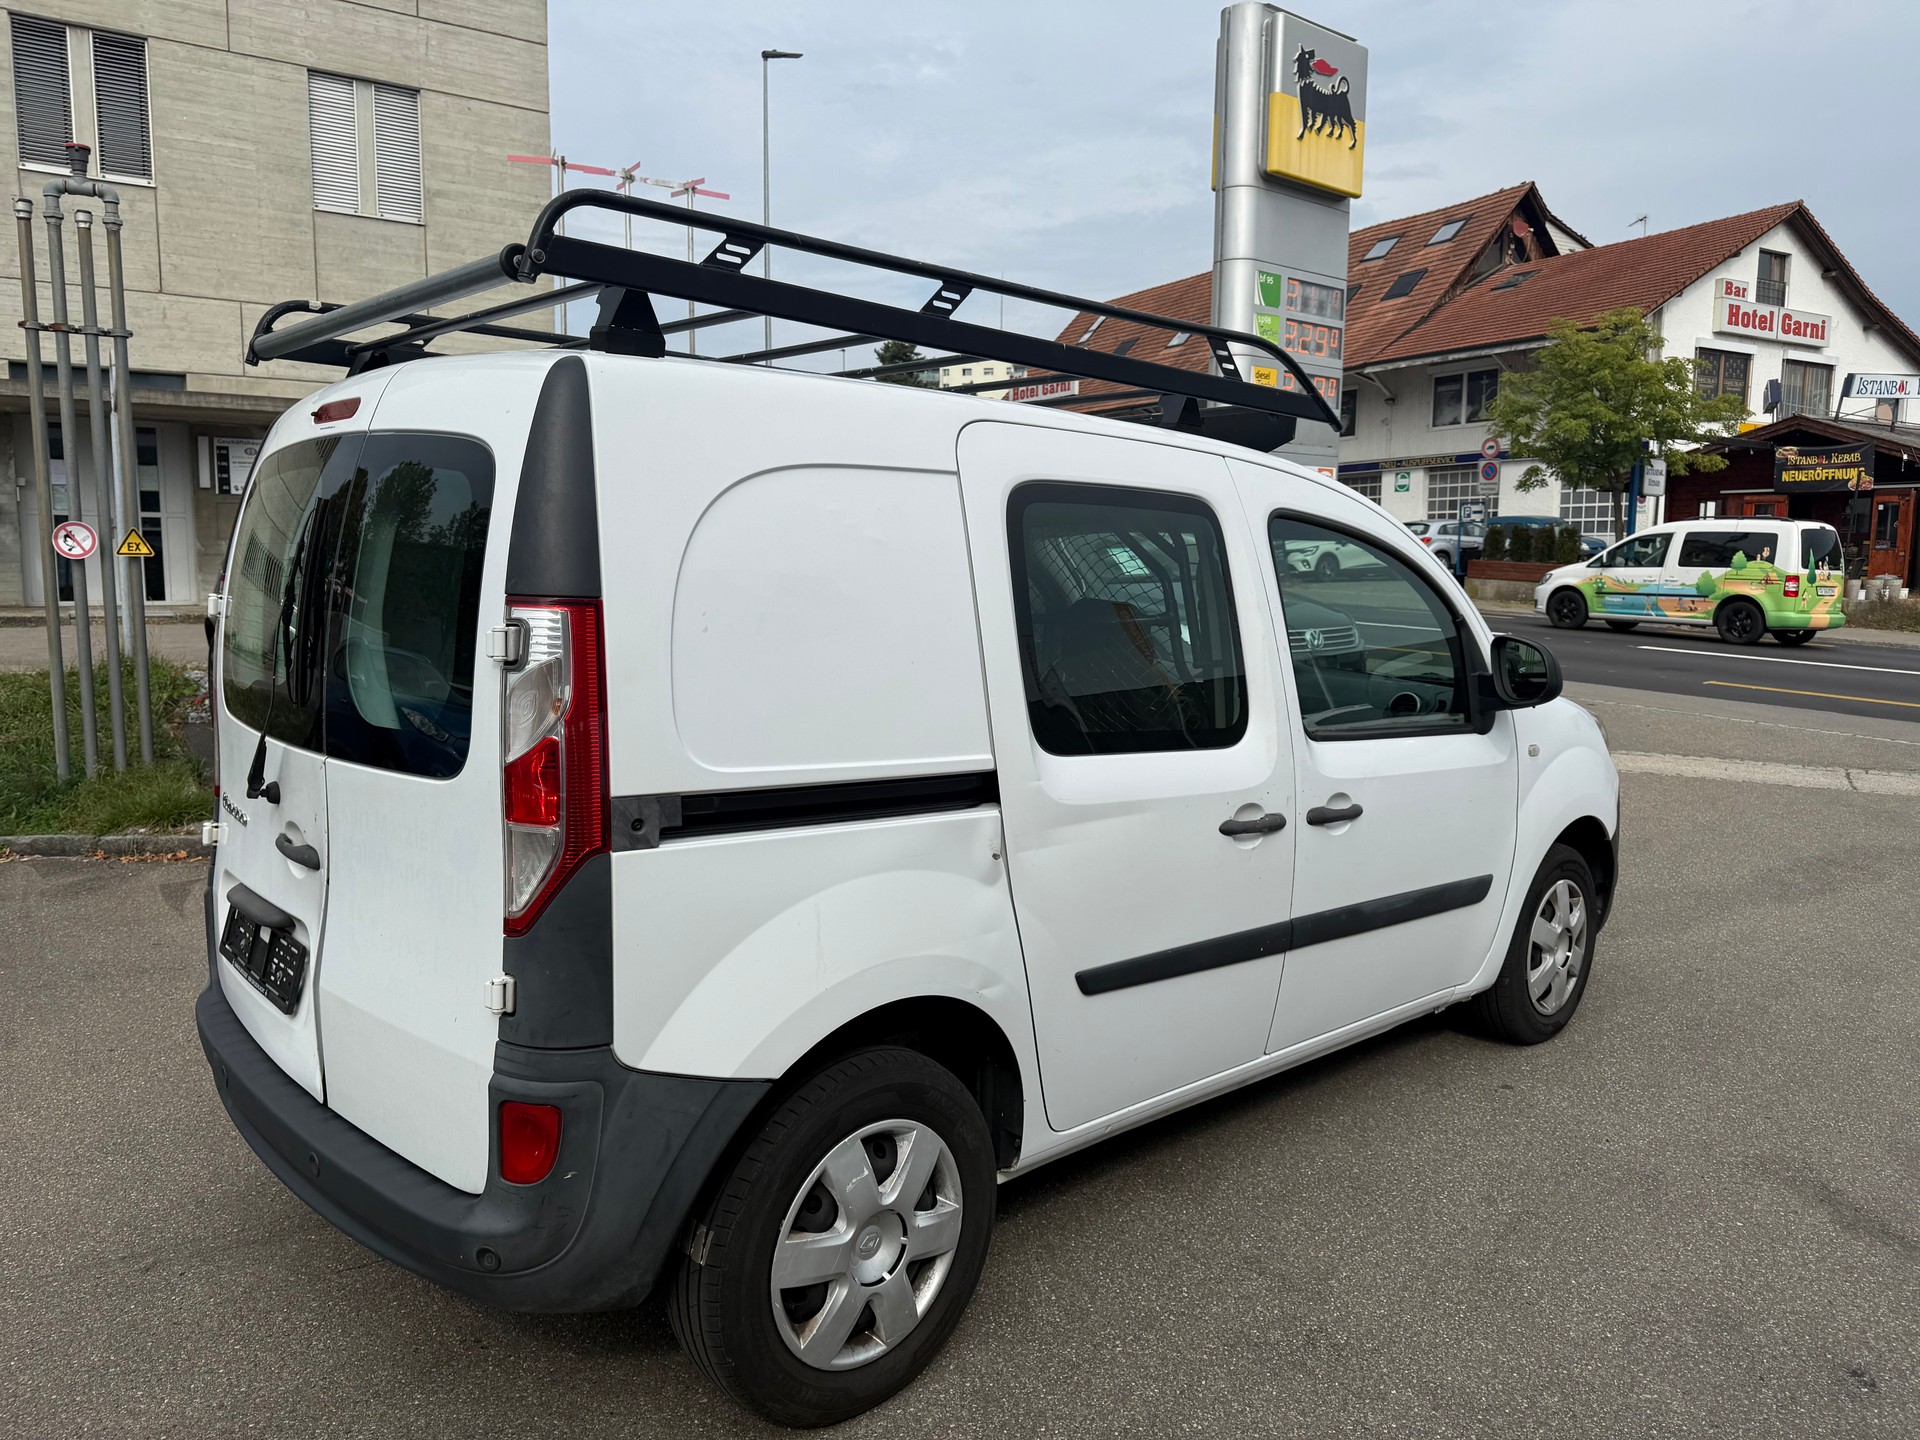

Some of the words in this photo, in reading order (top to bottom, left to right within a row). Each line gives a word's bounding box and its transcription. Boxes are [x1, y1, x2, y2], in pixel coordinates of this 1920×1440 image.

[1724, 280, 1747, 298] Bar
[1727, 303, 1775, 332] Hotel
[1781, 312, 1827, 341] Garni
[1255, 371, 1271, 380] diesel
[1012, 385, 1039, 401] Hotel
[1041, 381, 1071, 396] Garni
[1831, 453, 1862, 464] KEBAB
[127, 542, 142, 552] EX
